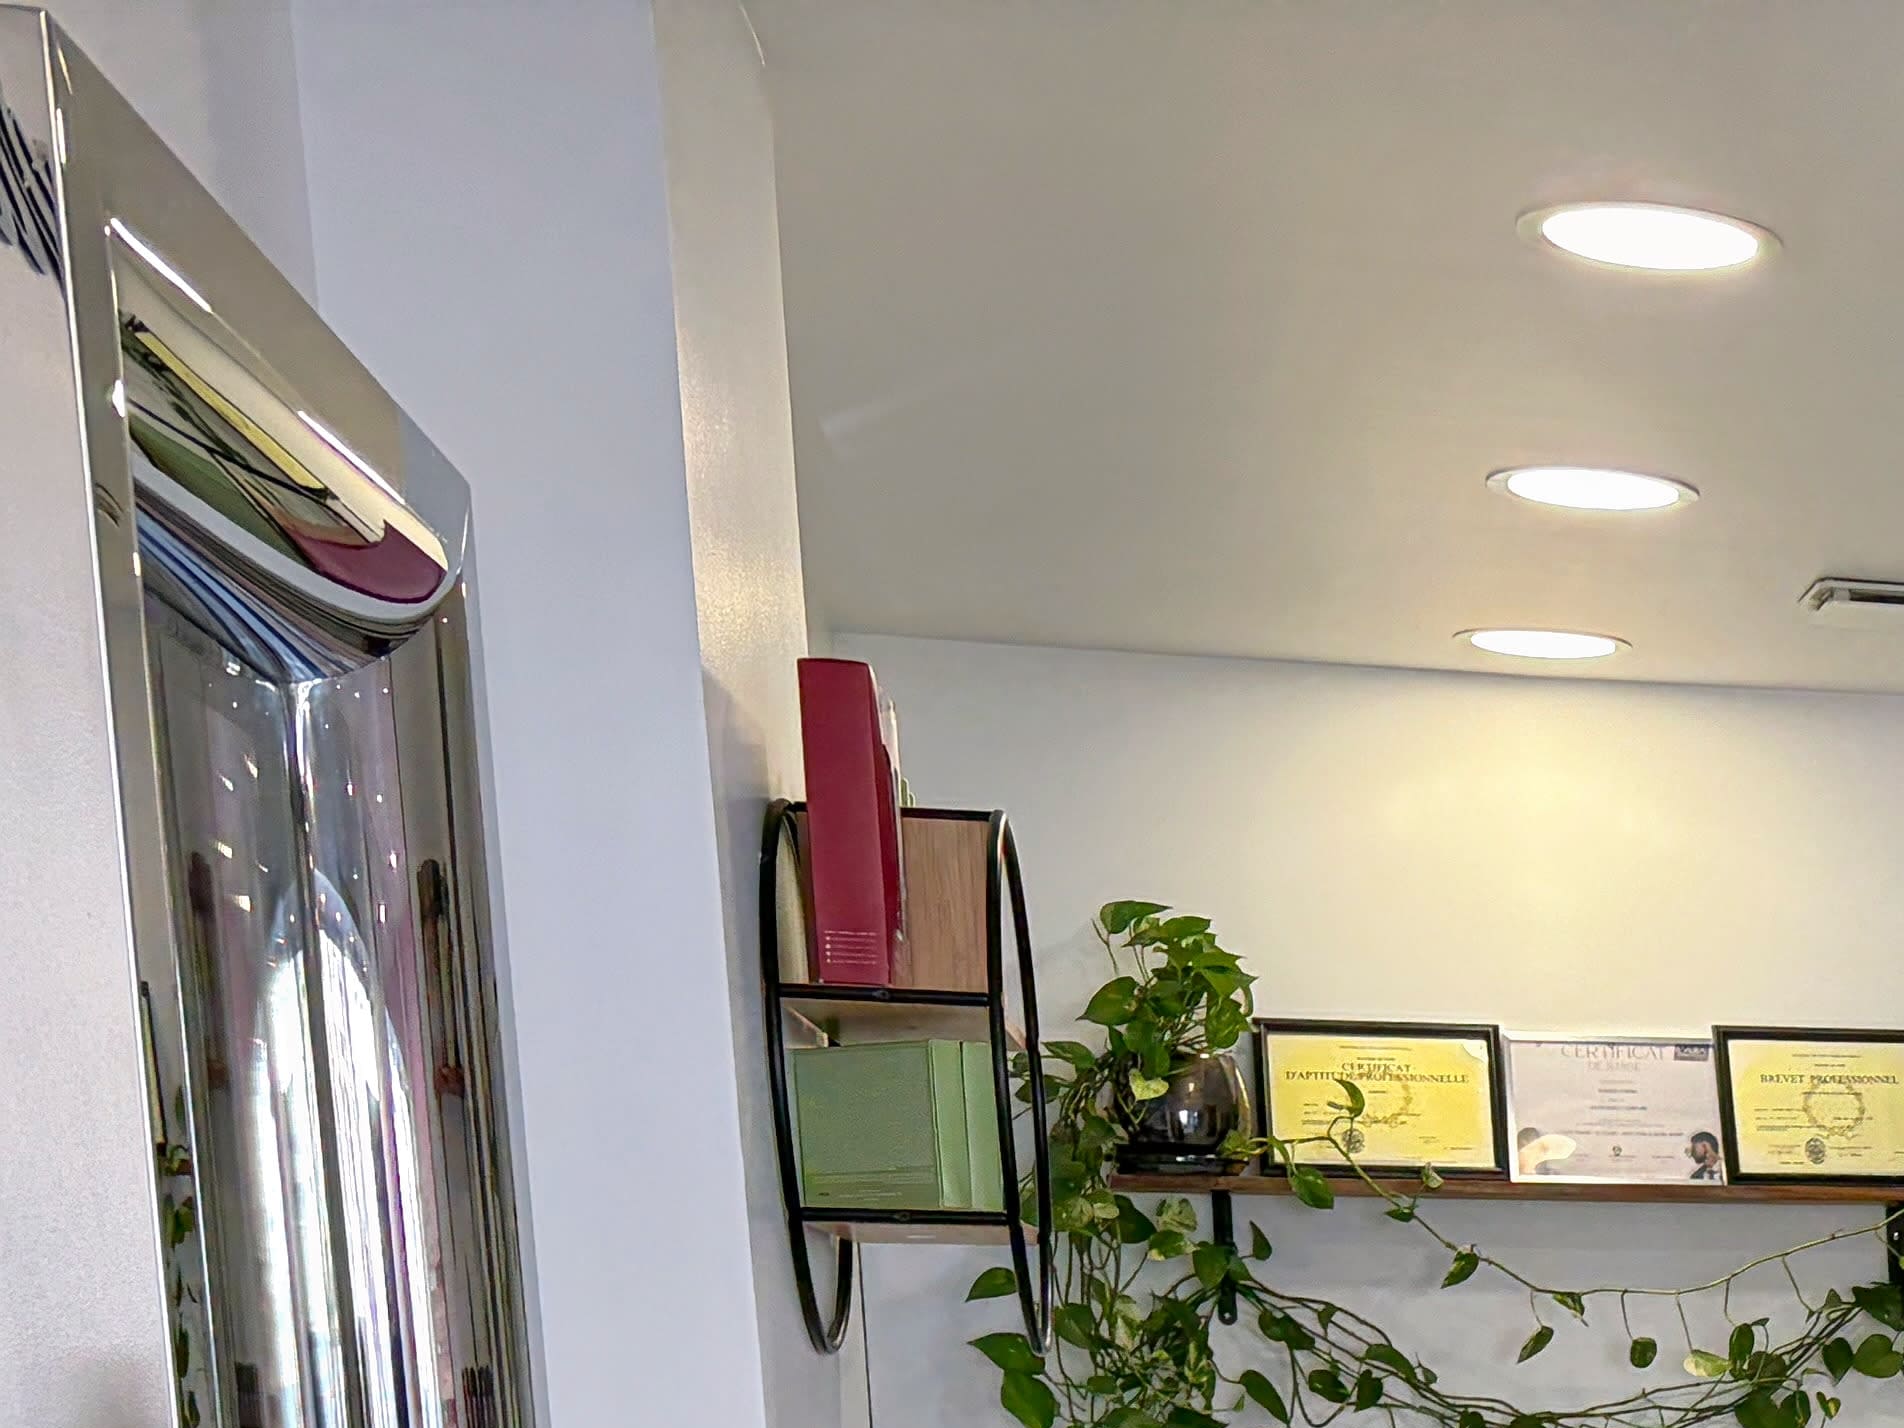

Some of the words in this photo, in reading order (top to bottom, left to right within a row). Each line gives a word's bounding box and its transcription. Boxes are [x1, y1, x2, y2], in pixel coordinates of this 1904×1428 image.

[1560, 1044, 1665, 1061] CERTIFICAT
[1341, 1062, 1412, 1073] CERTIFICAT
[1760, 1074, 1804, 1084] BREVET
[1810, 1074, 1899, 1085] PROFESSIONNEL
